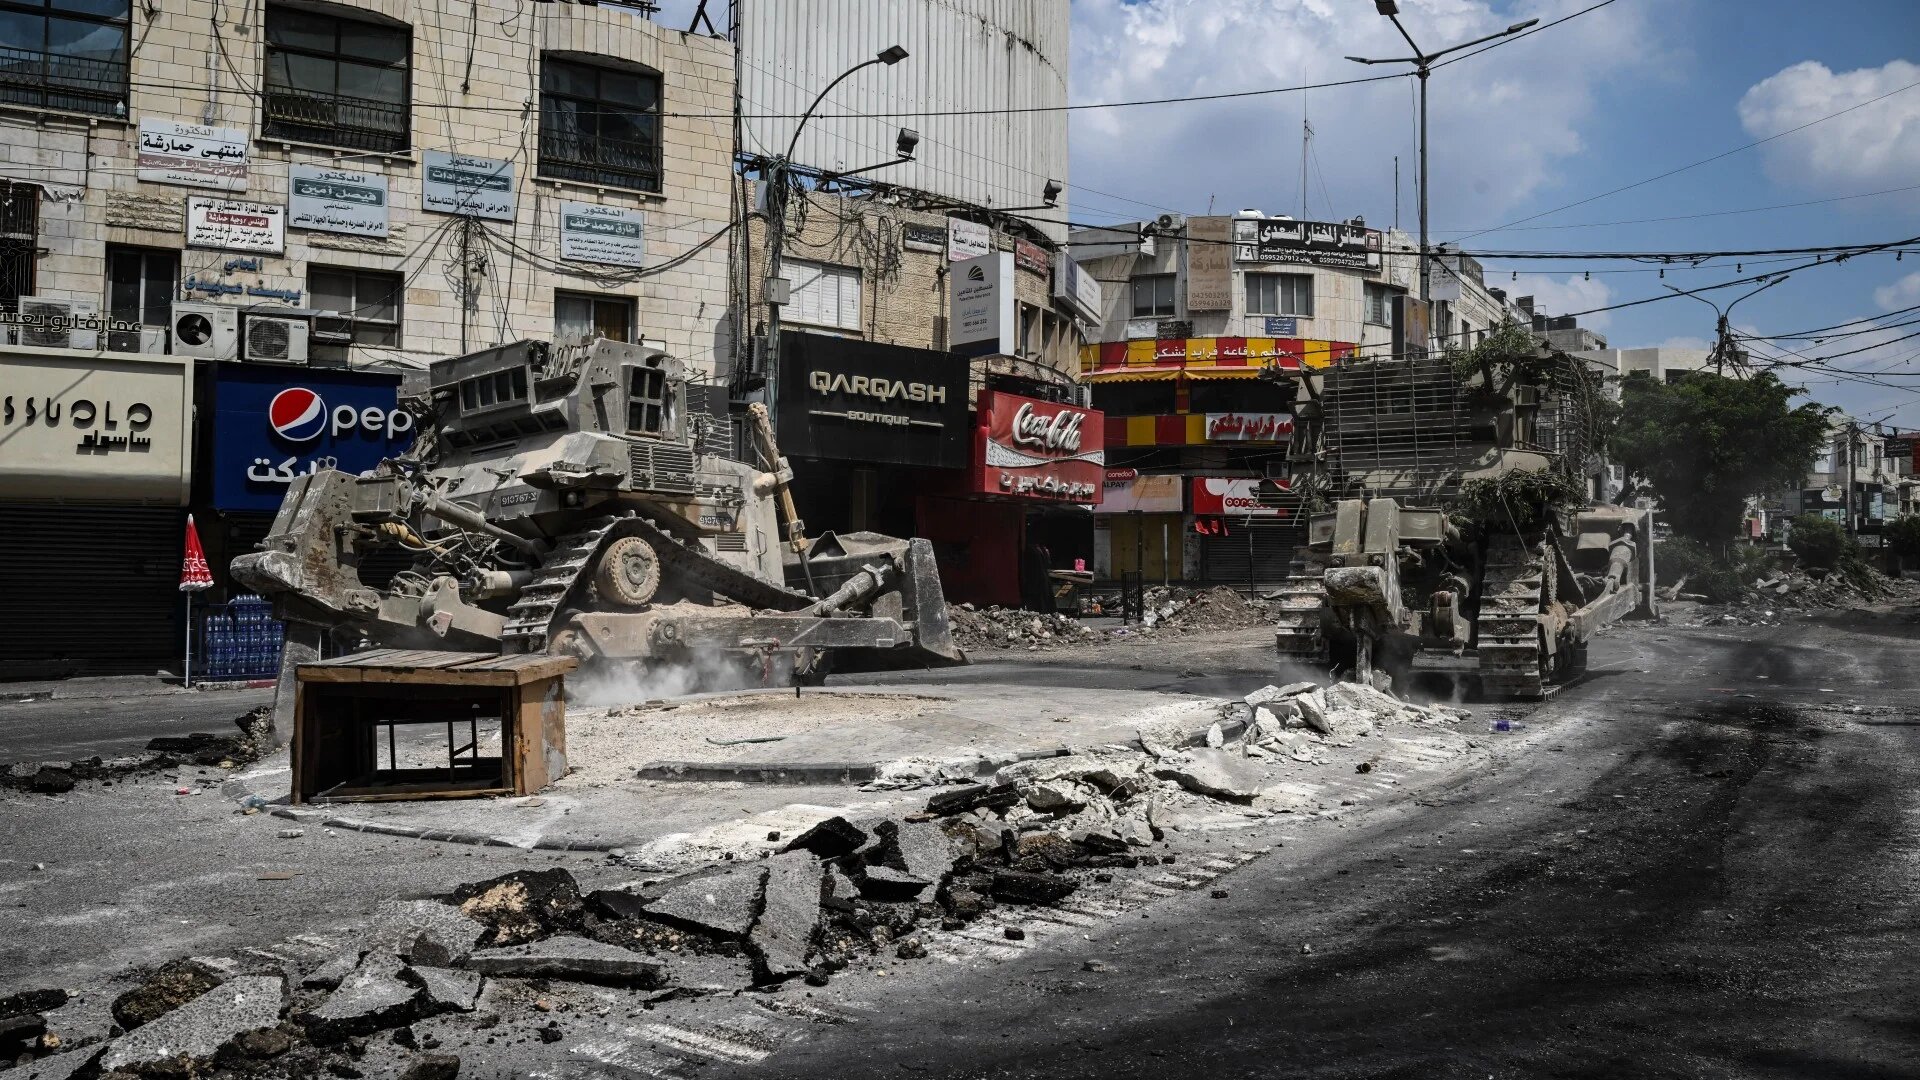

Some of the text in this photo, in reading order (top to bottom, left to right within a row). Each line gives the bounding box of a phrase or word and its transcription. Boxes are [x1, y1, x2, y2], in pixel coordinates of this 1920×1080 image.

[174, 124, 214, 136] الدكتورة
[142, 132, 195, 152] حمارشة
[448, 158, 493, 169] الدكتور
[315, 171, 366, 184] الدكتور
[335, 189, 377, 203] فيصل
[193, 200, 216, 211] الهندسي
[427, 194, 511, 213] الامراض الجلدية والتناسلية
[208, 212, 229, 222] حمارشة
[261, 205, 279, 217] مكتب
[582, 206, 624, 217] الدكتور
[569, 217, 636, 236] طارق محمد خلف
[253, 230, 273, 239] ترخيص
[1305, 224, 1337, 246] المختار
[1338, 226, 1366, 248] ستائر
[224, 256, 263, 276] المحامي
[84, 312, 142, 335] عمارة
[1152, 345, 1186, 360] تشكن
[1190, 346, 1218, 359] فرايد
[809, 370, 946, 404] QARQASH
[332, 404, 413, 440] pep
[847, 410, 910, 426] BOUTIQUE
[1108, 470, 1134, 478] ooredoo
